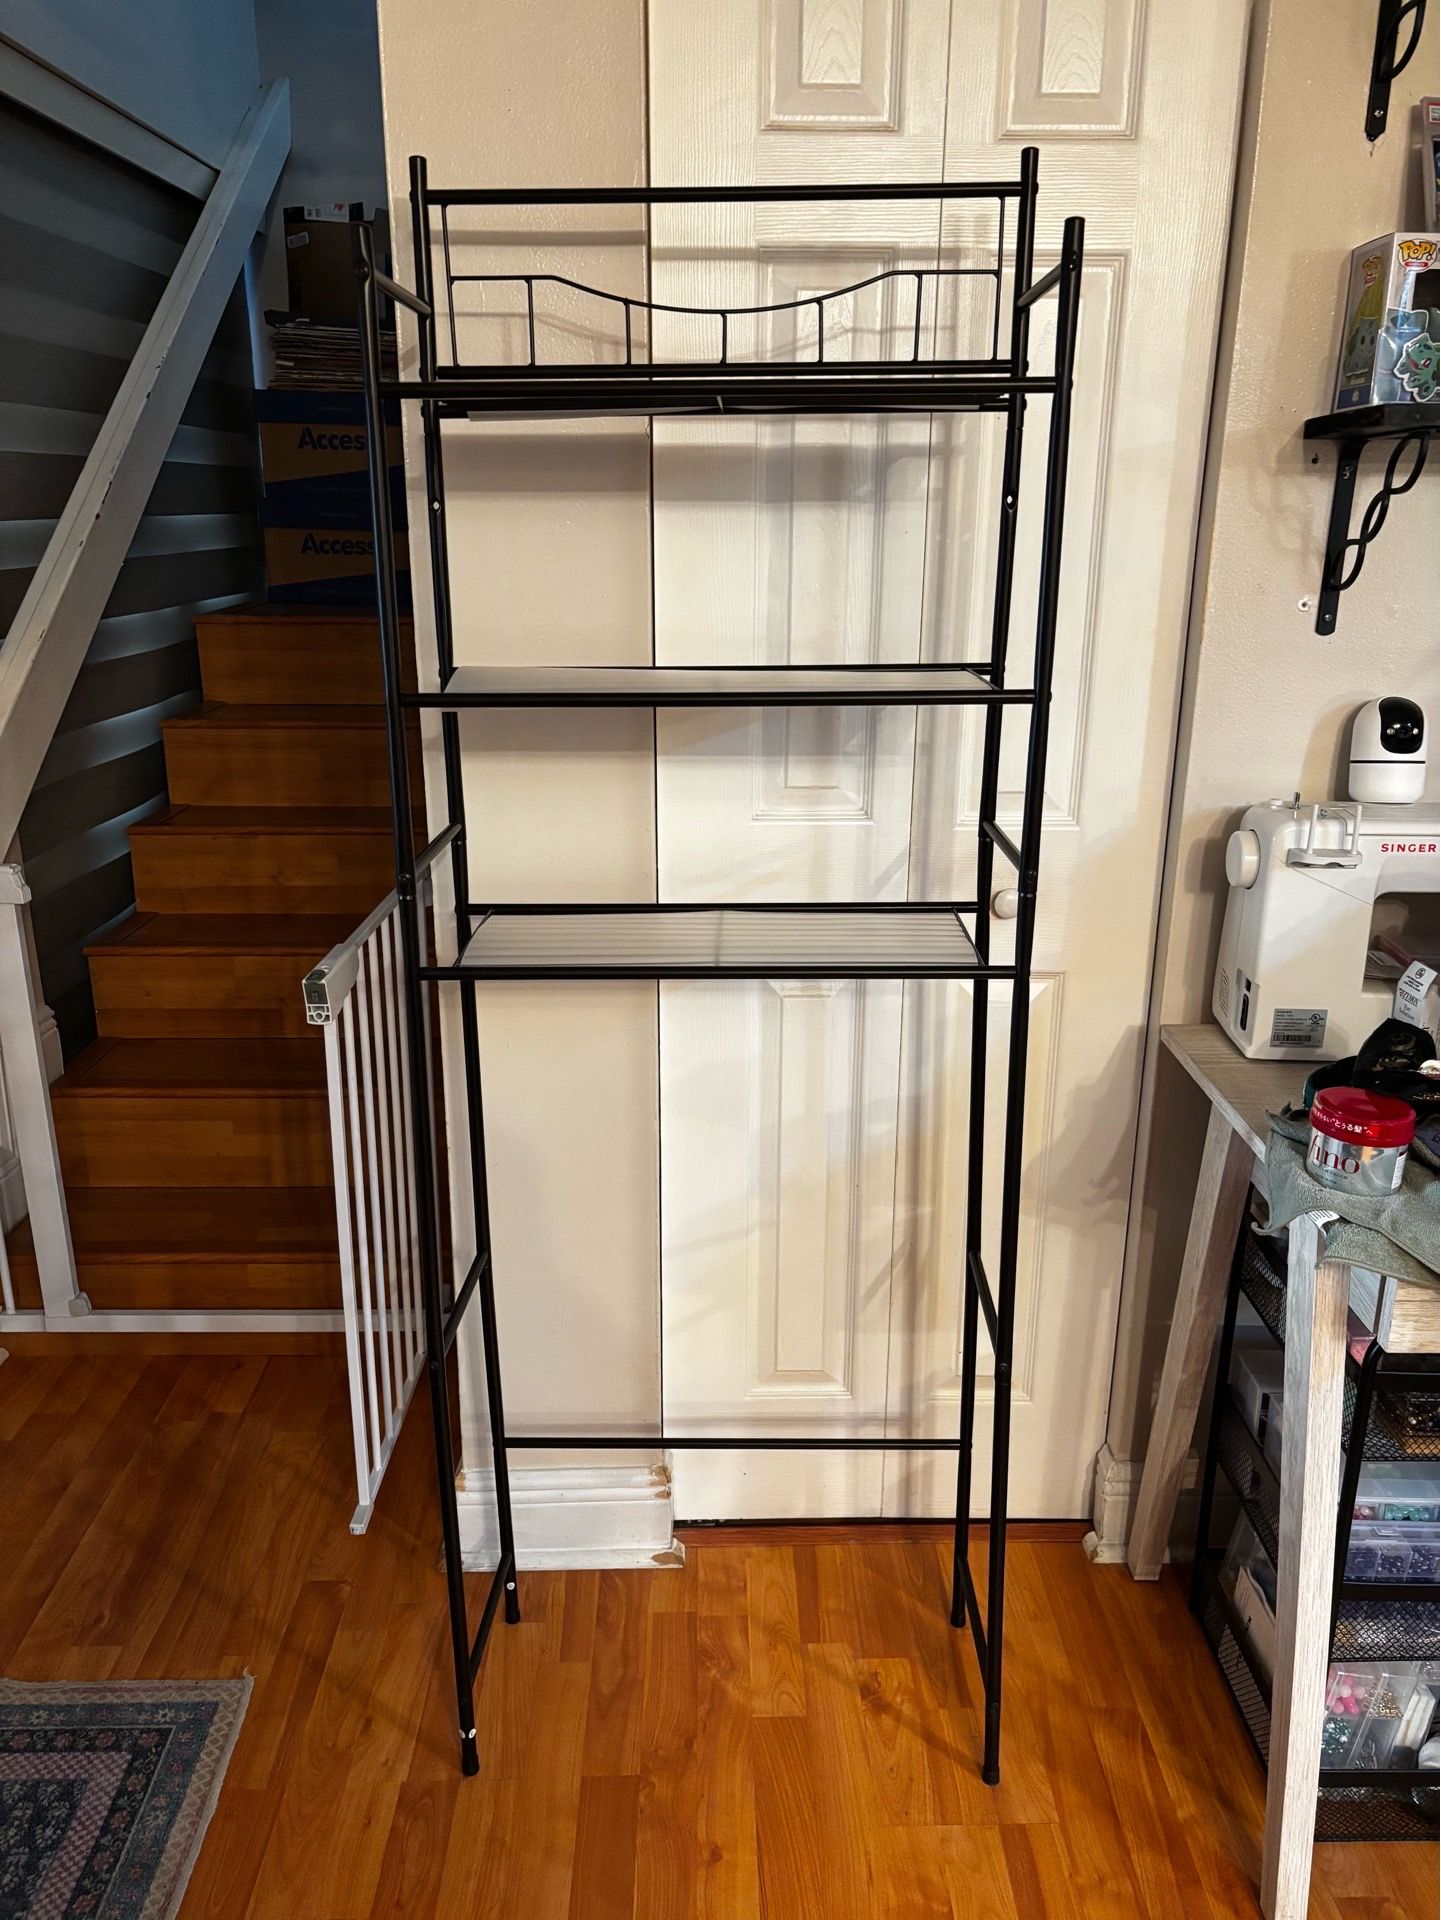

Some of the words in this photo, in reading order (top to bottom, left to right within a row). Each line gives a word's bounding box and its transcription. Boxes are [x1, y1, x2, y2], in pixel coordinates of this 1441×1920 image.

[1398, 240, 1437, 262] POP!
[298, 427, 366, 450] Acces
[1381, 843, 1437, 853] SINGER
